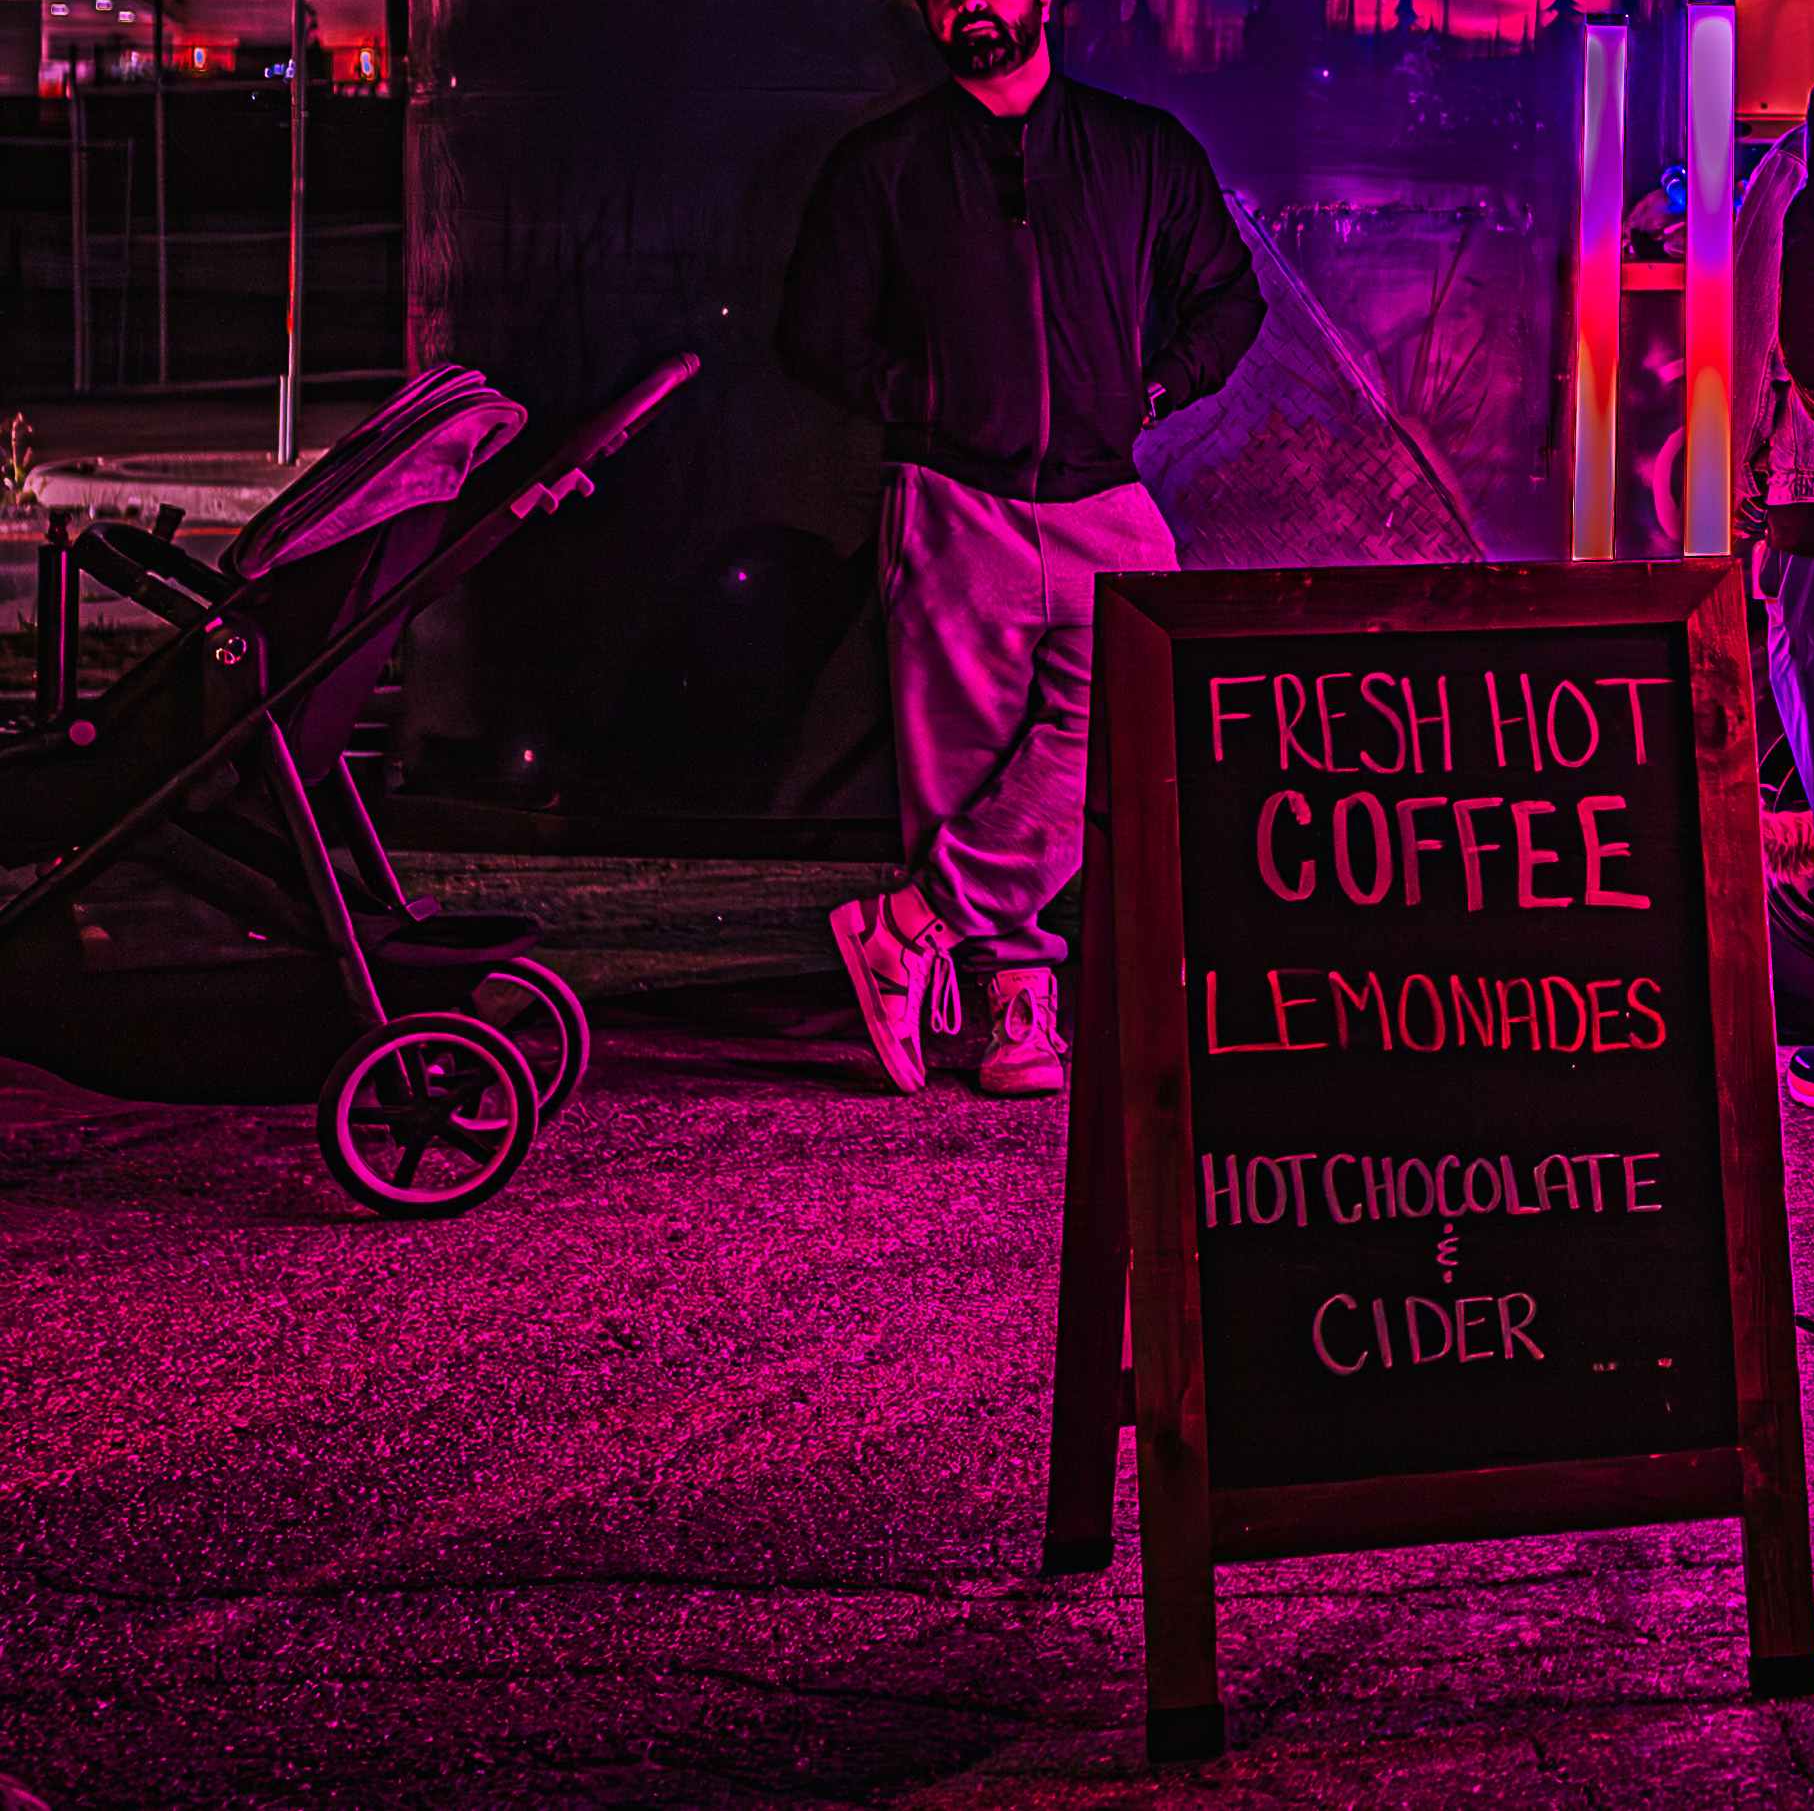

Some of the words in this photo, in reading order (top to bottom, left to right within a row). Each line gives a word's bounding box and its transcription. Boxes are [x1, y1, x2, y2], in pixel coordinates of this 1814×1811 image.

[1208, 671, 1453, 774] FRESH
[1483, 670, 1673, 772] HOT
[1256, 790, 1652, 911] COFFEE
[1205, 968, 1668, 1056] LEMONADES
[1313, 1293, 1544, 1373] CIDER
